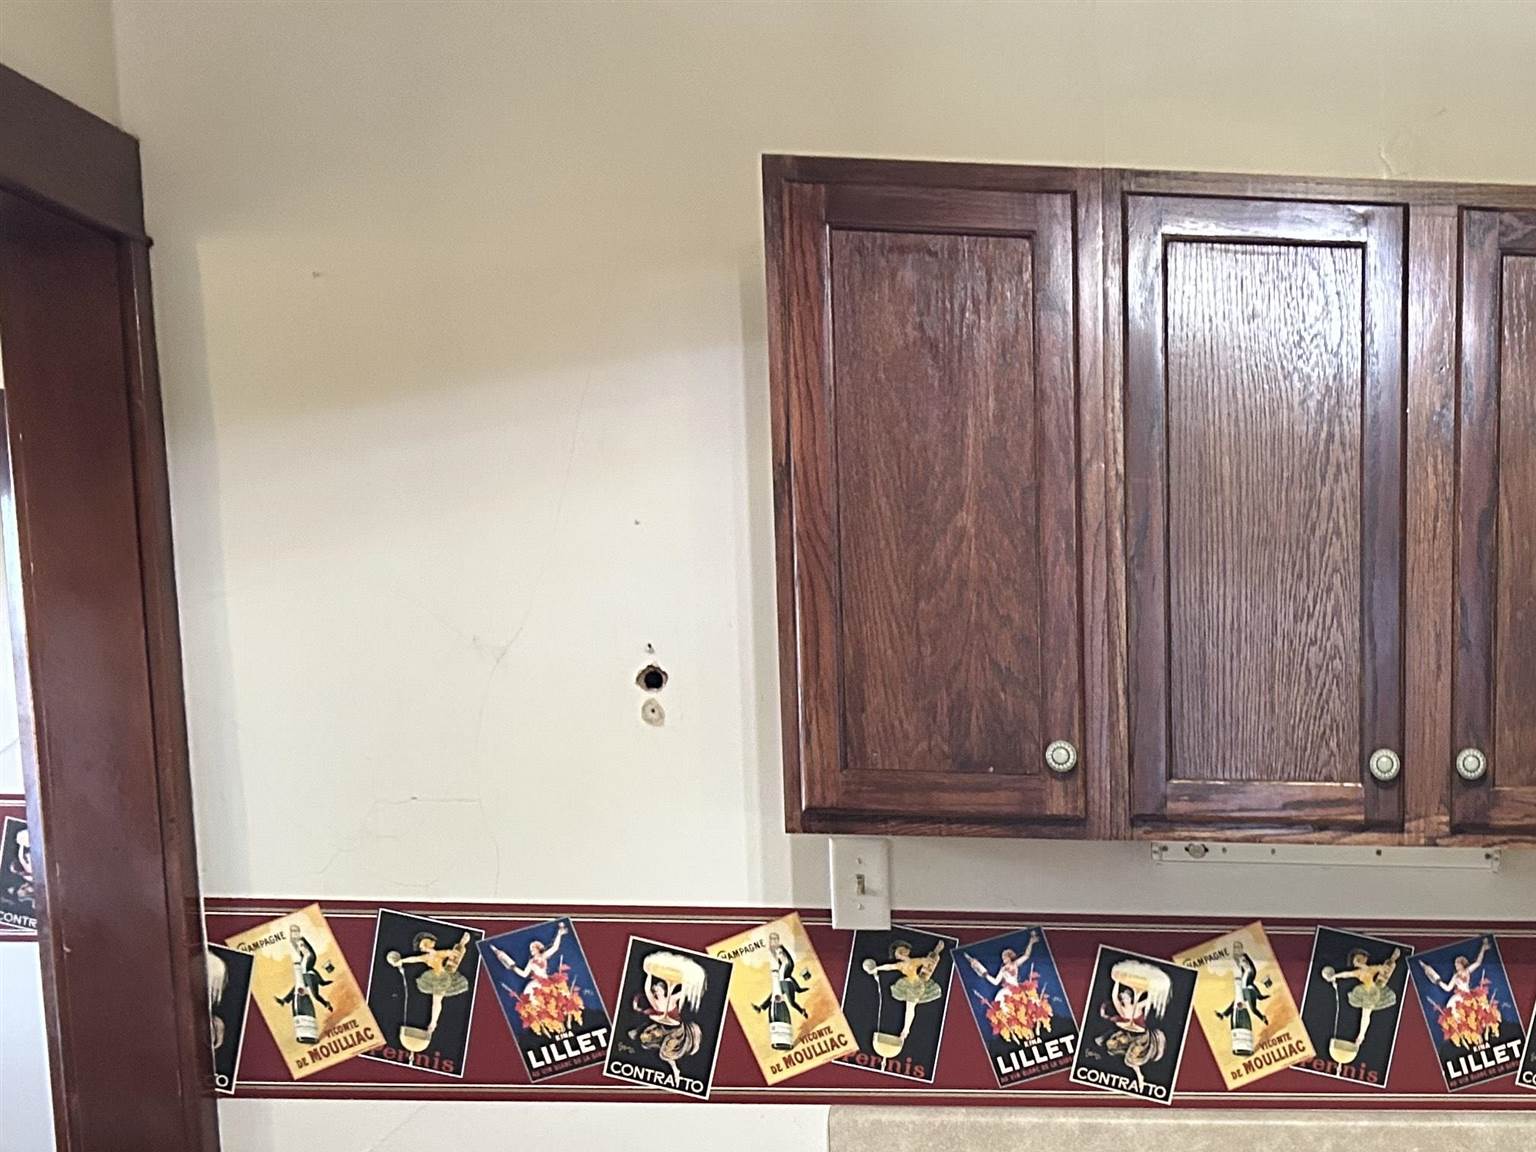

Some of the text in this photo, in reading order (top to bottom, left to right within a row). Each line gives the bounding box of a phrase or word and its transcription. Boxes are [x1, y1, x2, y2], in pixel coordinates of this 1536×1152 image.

[297, 1028, 375, 1069] DE MOULLIAC
[527, 1028, 608, 1069] LILLET
[770, 1034, 848, 1075] DE MOULLIAC
[996, 1034, 1075, 1075] LILLET
[1231, 1040, 1306, 1081] DE MOULLIAC
[1446, 1039, 1522, 1079] LILLET
[610, 1061, 704, 1093] CONTRATTO
[1076, 1067, 1167, 1099] CONTRATTO
